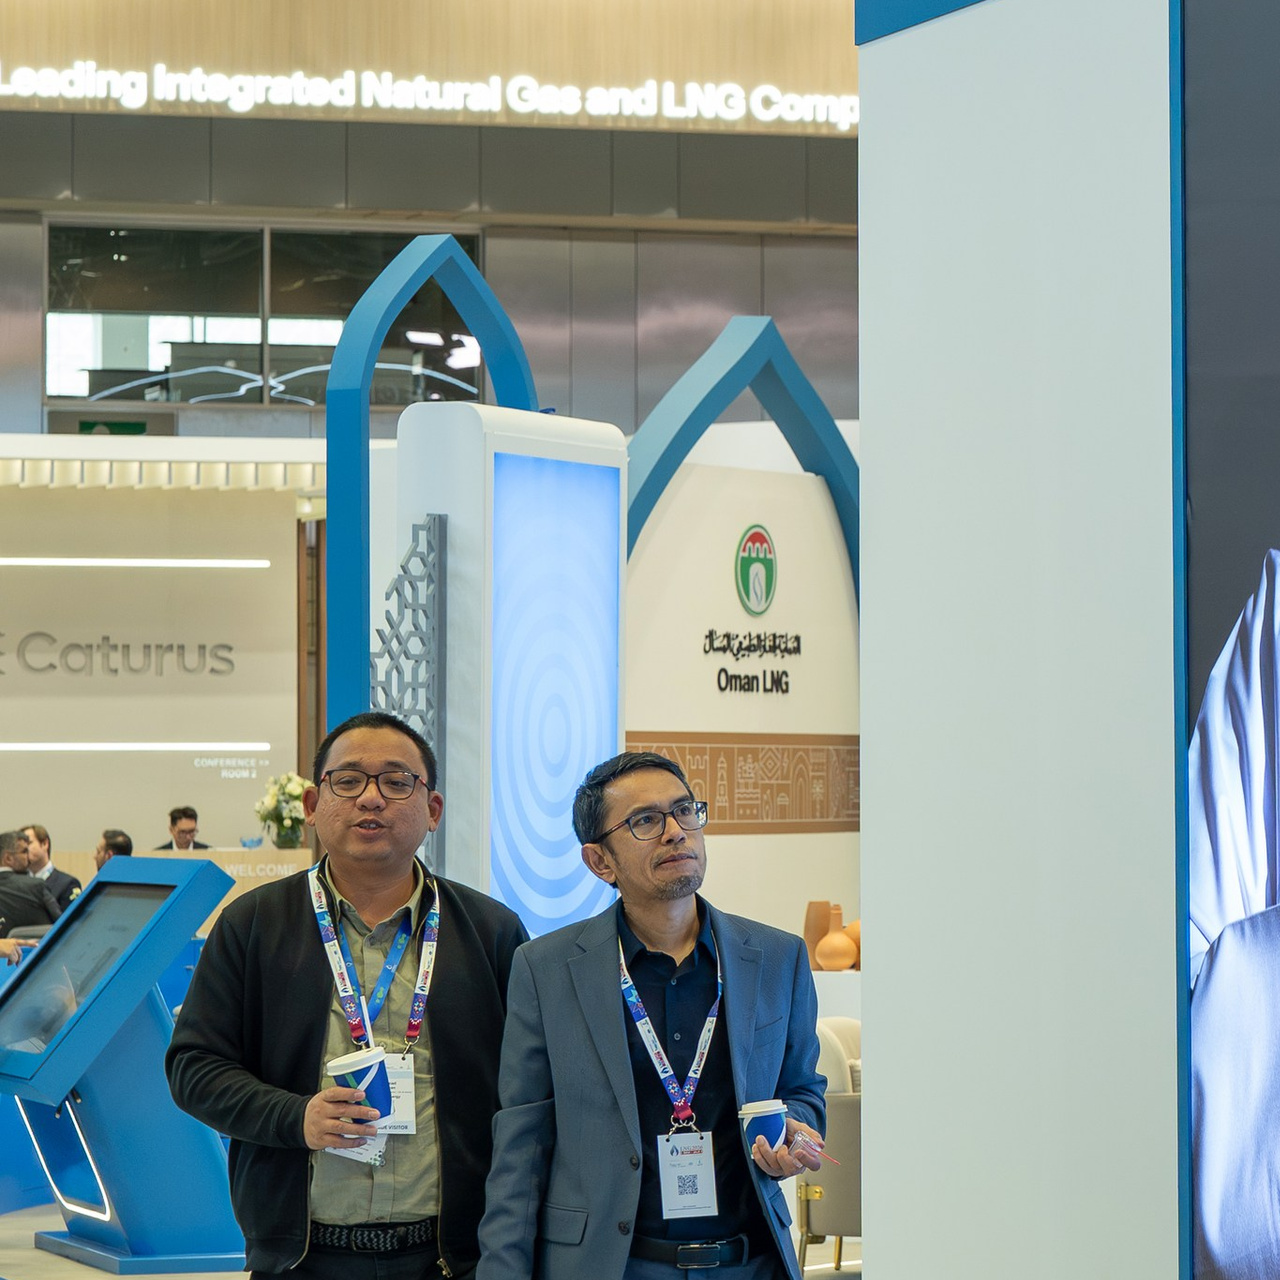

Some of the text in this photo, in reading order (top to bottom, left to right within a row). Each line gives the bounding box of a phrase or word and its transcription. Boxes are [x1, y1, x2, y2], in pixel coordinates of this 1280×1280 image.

[153, 63, 356, 112] Integrated
[361, 71, 502, 111] Natural
[506, 74, 582, 113] Gas
[585, 79, 657, 116] and
[662, 81, 746, 120] LNG
[16, 631, 235, 677] Caturus
[717, 667, 789, 694] Oman LNG
[194, 758, 256, 768] CONFERENCE
[221, 768, 249, 778] ROOM
[225, 864, 298, 877] WELCOME
